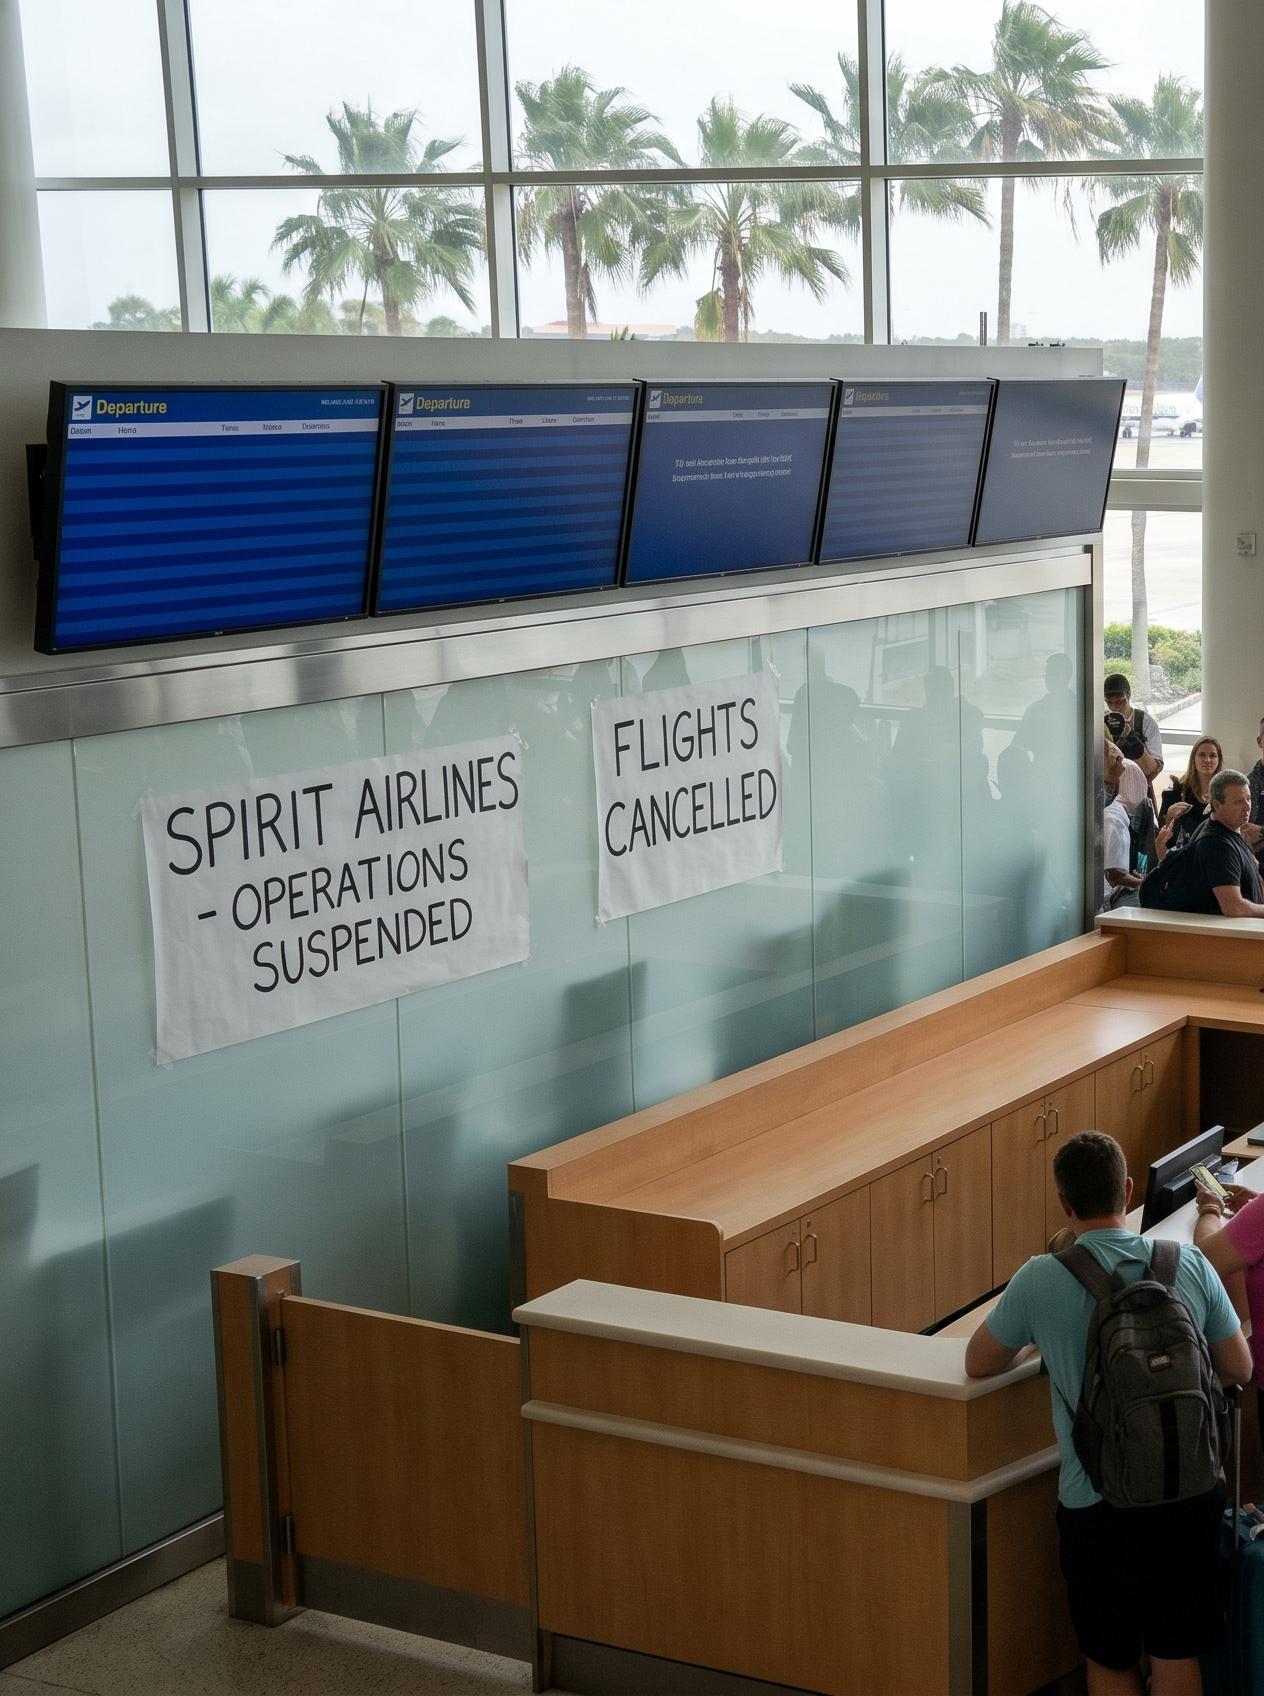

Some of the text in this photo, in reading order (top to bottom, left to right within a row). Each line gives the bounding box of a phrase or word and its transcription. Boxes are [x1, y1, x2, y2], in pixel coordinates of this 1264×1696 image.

[96, 399, 168, 418] Departure
[416, 397, 470, 412] Departure
[663, 392, 704, 406] Departure
[614, 697, 758, 778] FLIGHTS
[166, 751, 519, 876] SPIRIT AIRLINES
[605, 768, 778, 857] CANCELLED
[232, 838, 469, 931] OPERATIONS
[253, 897, 473, 993] SUSPENDED
